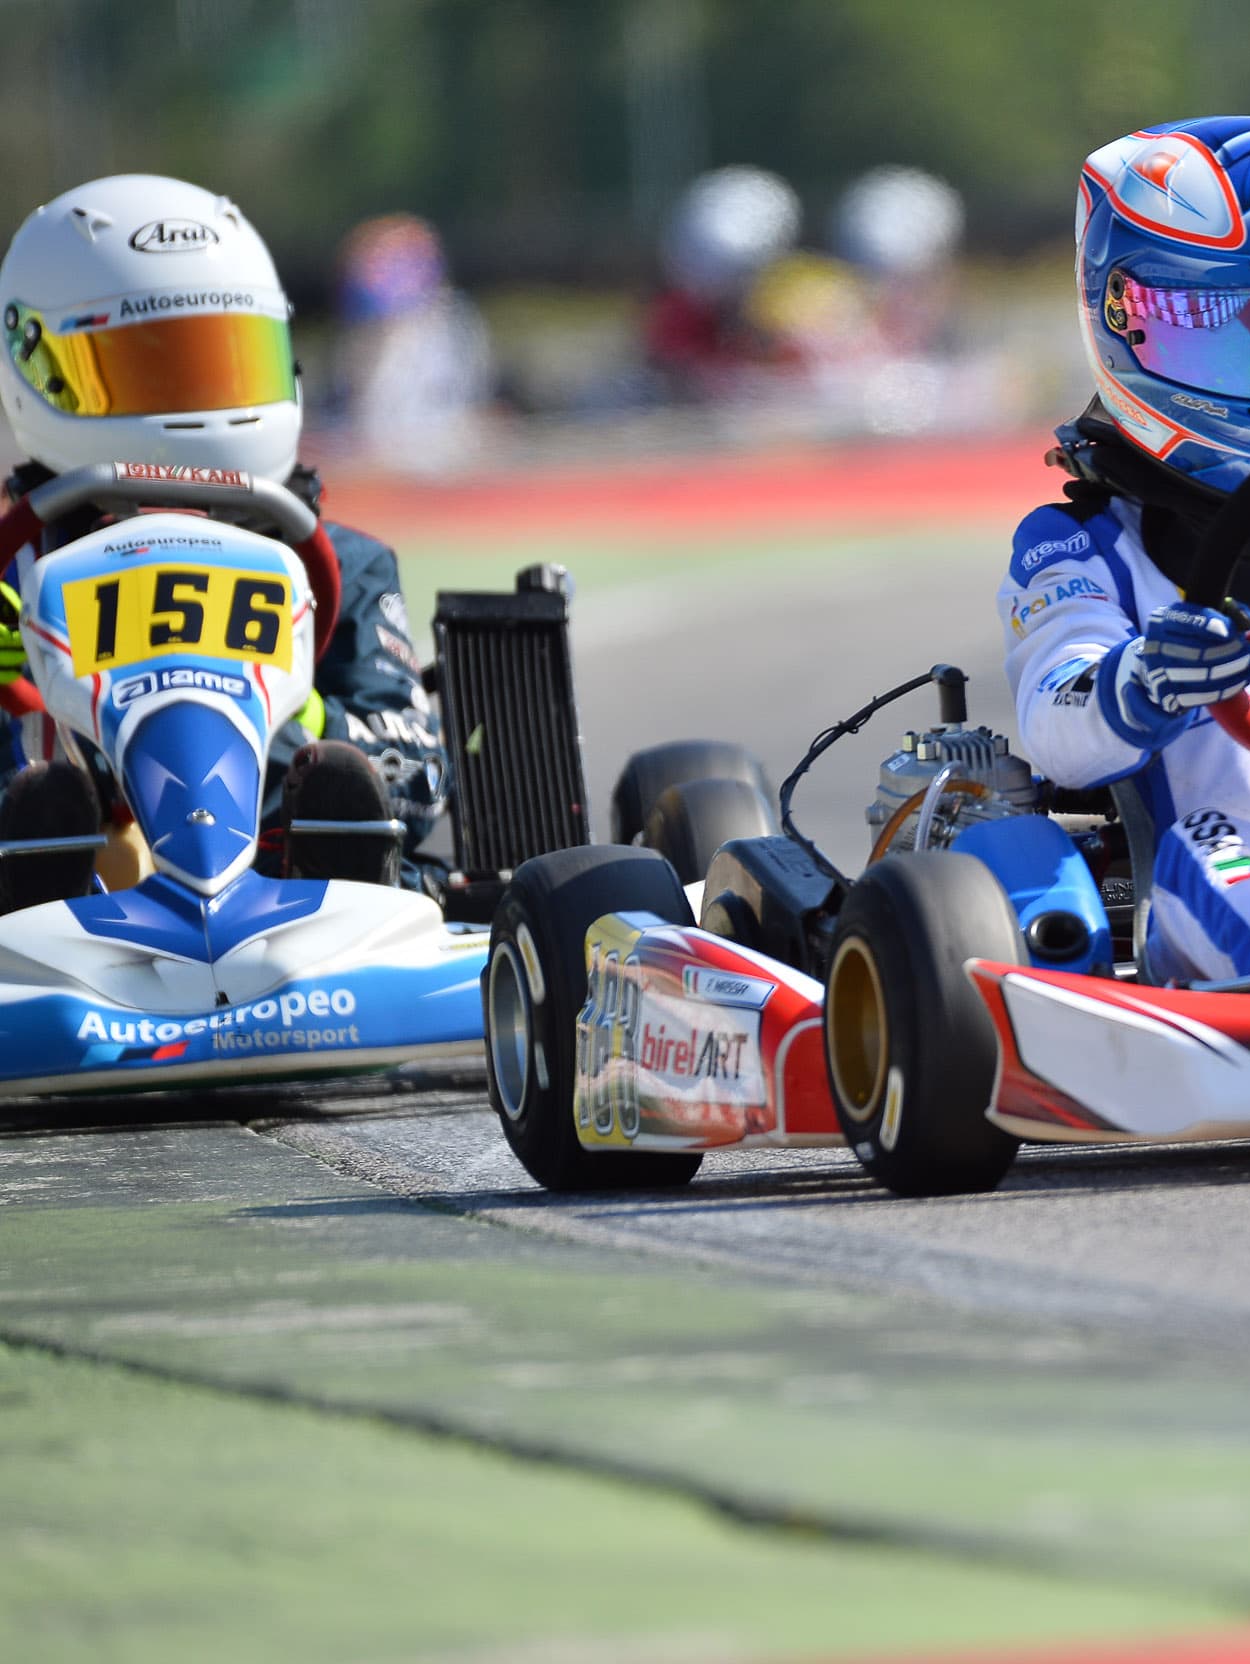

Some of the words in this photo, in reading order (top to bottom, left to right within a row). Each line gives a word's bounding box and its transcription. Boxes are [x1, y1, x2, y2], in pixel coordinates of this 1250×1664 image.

[141, 223, 207, 244] Arai
[120, 291, 254, 318] Autoeuropeo
[104, 536, 221, 553] Autoeuropeo
[95, 570, 286, 663] 156
[77, 988, 357, 1043] Autoeuropeo
[212, 1024, 359, 1050] Motorsport
